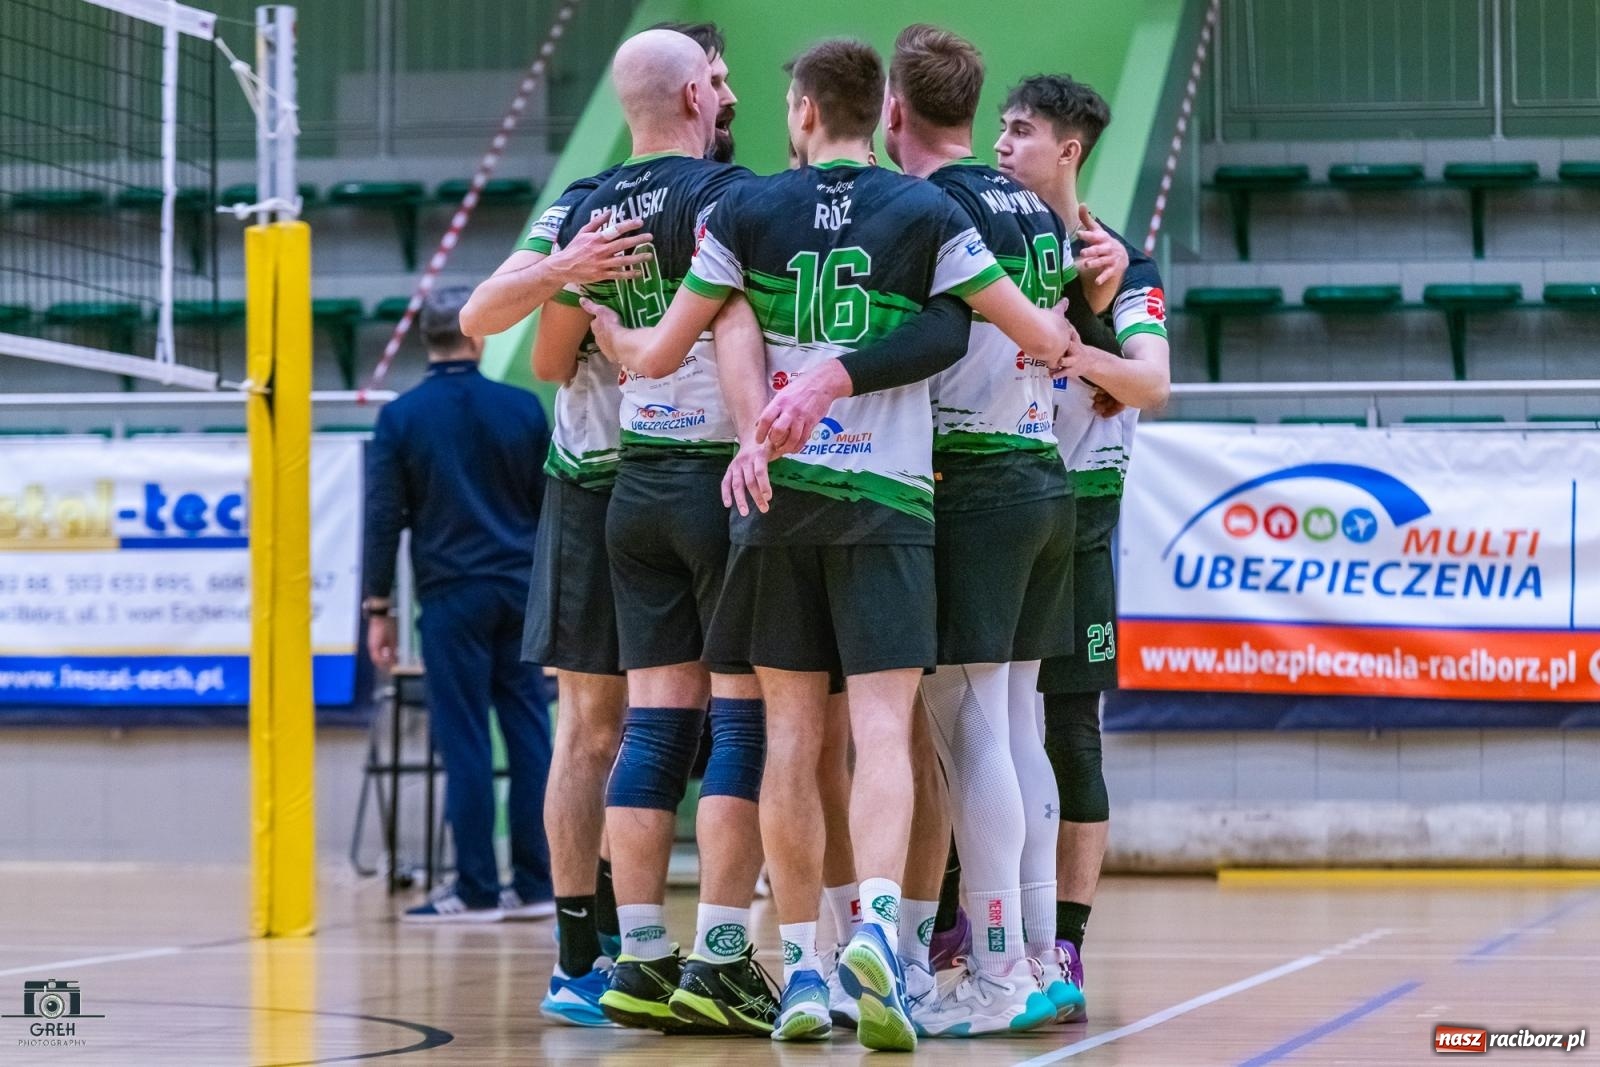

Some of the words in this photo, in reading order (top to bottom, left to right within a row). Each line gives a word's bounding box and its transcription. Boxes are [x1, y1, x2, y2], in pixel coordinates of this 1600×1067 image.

[814, 195, 852, 230] RÓŻ
[787, 246, 871, 346] 16
[631, 415, 706, 431] UBEZPIECZENIA
[836, 432, 873, 443] MULTI
[800, 442, 872, 455] ZPIECZENIA
[1403, 528, 1540, 558] MULTI
[1174, 553, 1543, 598] UBEZPIECZENIA
[1087, 621, 1116, 662] 23
[1140, 642, 1576, 690] www.ubezpieczenia-raciborz.pl
[990, 928, 1003, 951] XMAS
